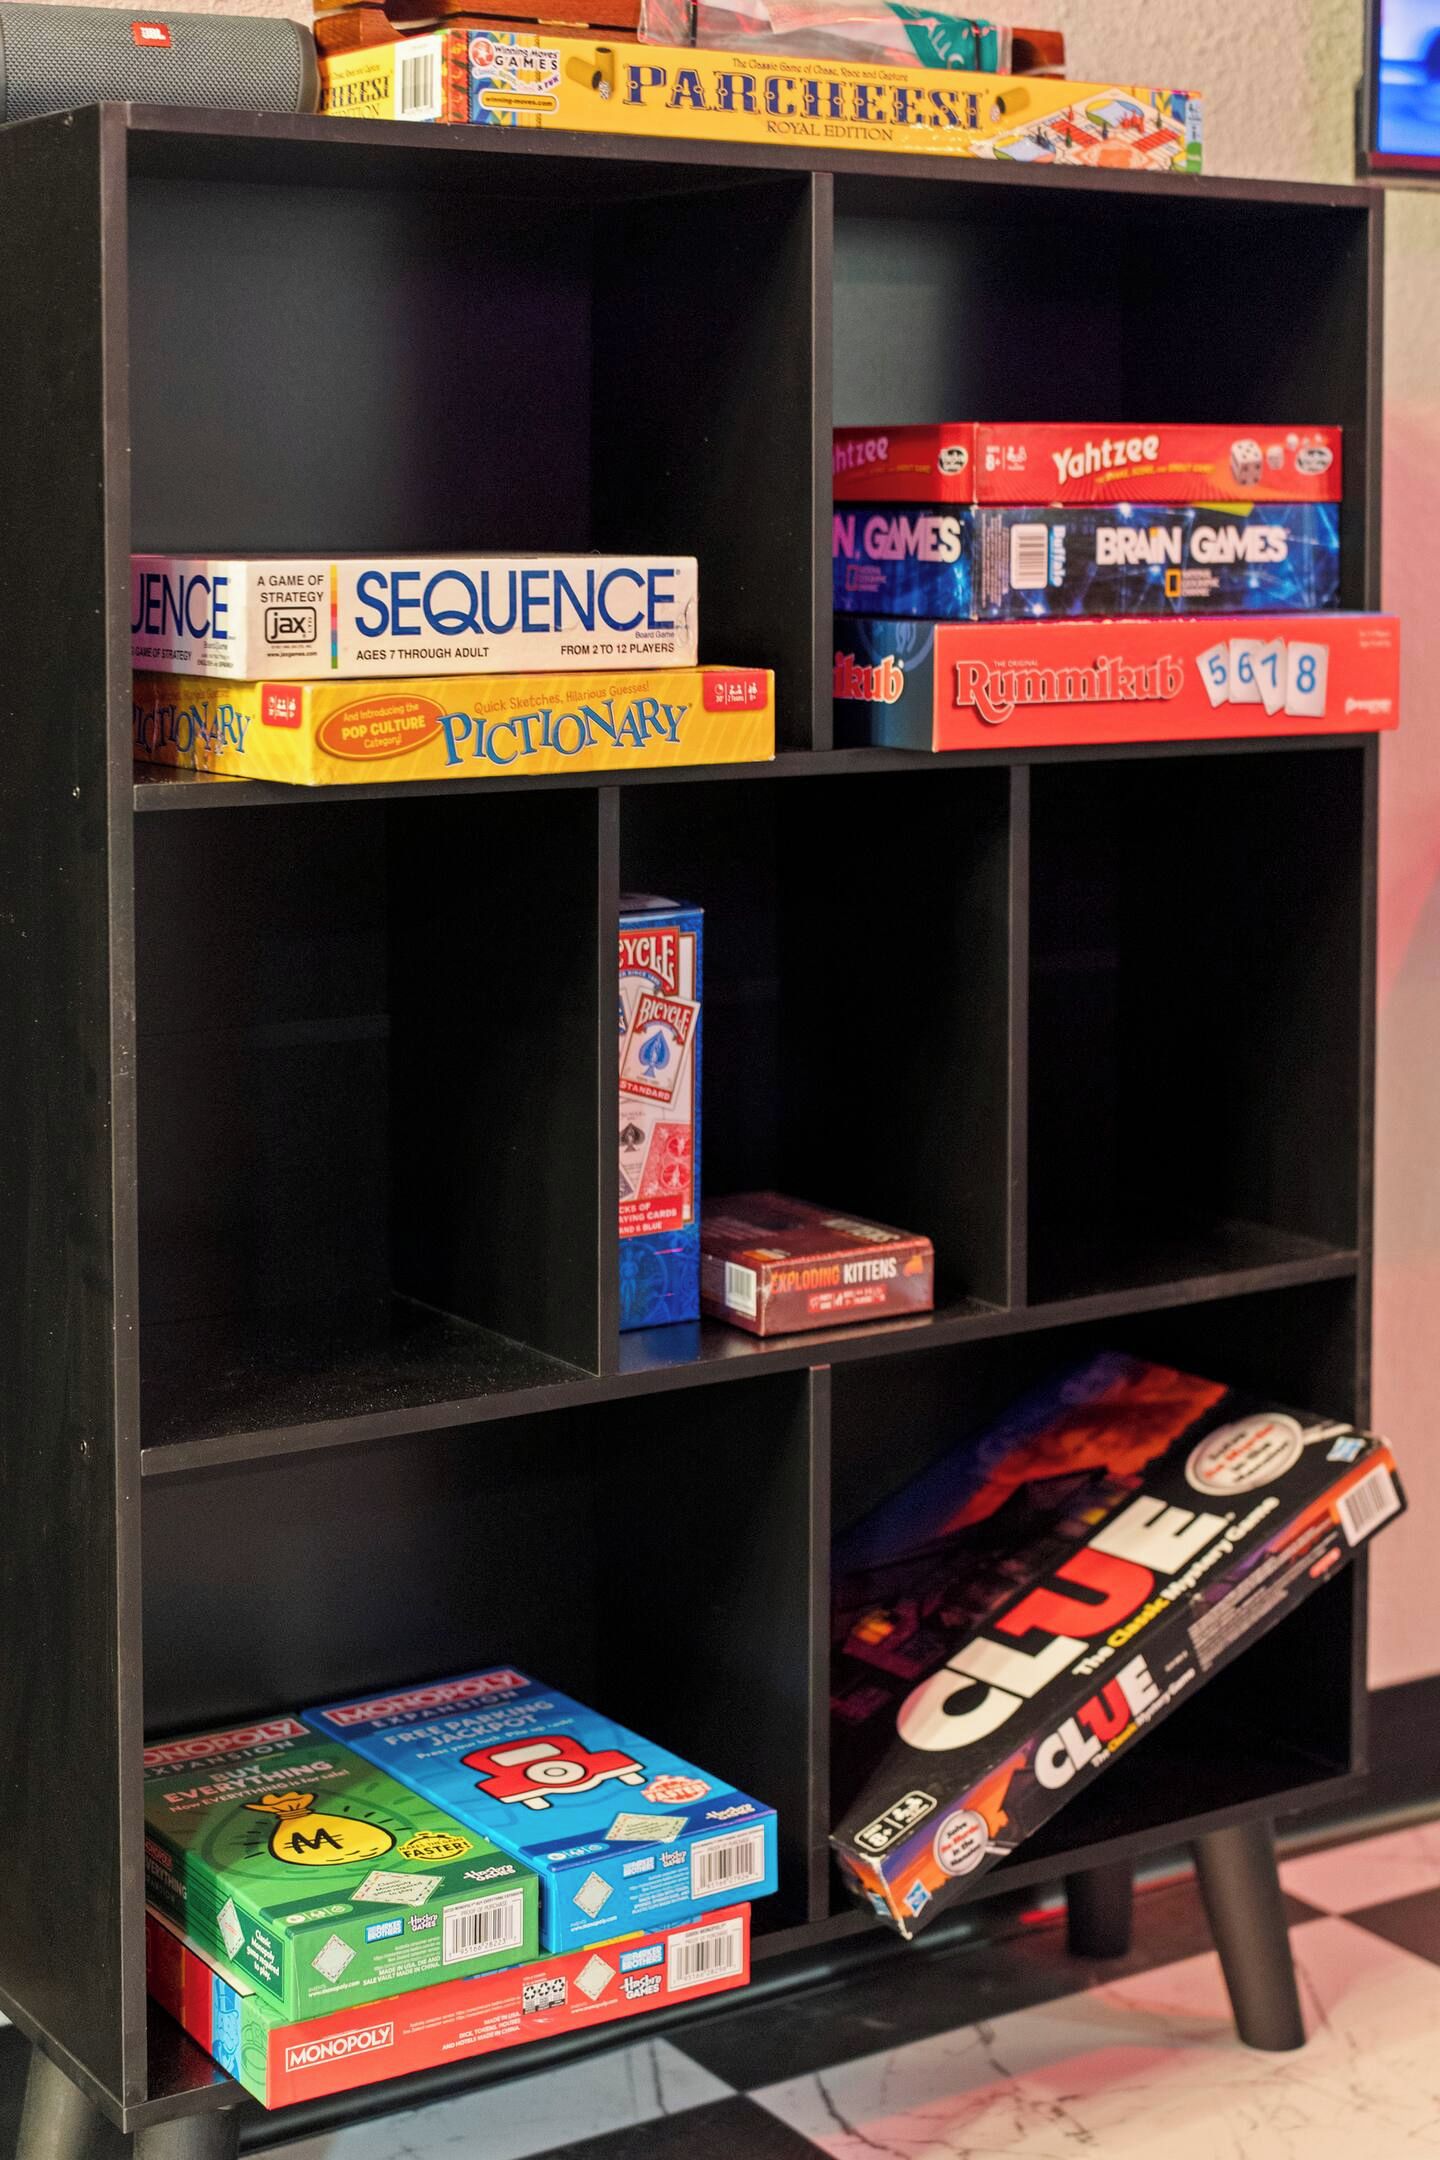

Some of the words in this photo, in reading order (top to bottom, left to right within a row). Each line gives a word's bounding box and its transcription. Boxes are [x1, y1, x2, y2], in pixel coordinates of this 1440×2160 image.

[495, 56, 558, 70] GAMES
[733, 58, 746, 67] The
[749, 60, 778, 70] Classic
[780, 63, 801, 72] Game
[623, 65, 985, 131] PARCHEESI
[767, 120, 821, 136] ROYAL
[824, 122, 893, 141] EDITION
[1052, 435, 1160, 486] Yahtzee
[864, 516, 962, 563] GAMES
[1190, 526, 1289, 564] GAMES
[257, 576, 265, 586] A
[269, 575, 304, 586] GAME
[308, 575, 324, 586] OF
[260, 591, 324, 603] STRATEGY
[355, 568, 674, 638] SEQUENCE
[271, 612, 306, 639] jax
[635, 631, 654, 639] Board
[656, 631, 674, 639] Game
[356, 649, 387, 660] AGES
[390, 649, 396, 660] 7
[399, 648, 452, 659] THROUGH
[455, 647, 489, 658] ADULT
[561, 645, 590, 655] FROM
[593, 644, 599, 655] 2
[601, 644, 613, 655] TO
[616, 644, 627, 654] 12
[630, 643, 674, 653] PLAYERS
[1208, 655, 1227, 686] 5
[1238, 652, 1253, 684] 6
[1261, 653, 1278, 688] 7
[1296, 654, 1316, 694] 8
[474, 700, 507, 714] Quick
[510, 694, 564, 709] Sketches,
[566, 688, 607, 701] Hilarious
[609, 681, 650, 697] Guesses!
[955, 655, 1184, 724] Rummikub
[344, 712, 359, 722] And
[360, 706, 405, 720] Introducing
[406, 702, 419, 711] the
[342, 725, 368, 740] POP
[370, 715, 426, 736] CULTURE
[436, 697, 687, 767] PICTIONARY
[364, 734, 402, 748] Category!
[638, 996, 692, 1042] BICYCLE
[619, 1080, 671, 1101] STANDARD
[638, 1203, 651, 1211] OF
[647, 1209, 677, 1220] CARDS
[643, 1222, 662, 1231] BLUE
[770, 1265, 840, 1295] EXPLODING
[844, 1257, 898, 1284] KITTENS
[1072, 1646, 1115, 1675] The
[1225, 1497, 1280, 1542] Game
[896, 1495, 1230, 1752] CLUE
[335, 1672, 514, 1724] MONOPOLY
[370, 1689, 519, 1728] EXPANSION
[384, 1724, 446, 1746] FREE
[444, 1700, 555, 1730] PARKING
[430, 1714, 539, 1747] JACKPOT
[1034, 1654, 1160, 1790] CLUE
[162, 1760, 334, 1804] EVERYTHING
[209, 1765, 262, 1782] BUY
[170, 1803, 200, 1813] Now
[203, 1783, 288, 1806] EVERYTHING
[290, 1779, 300, 1787] is
[301, 1775, 319, 1784] for
[403, 1841, 470, 1858] FASTER!
[427, 1840, 441, 1848] THE
[443, 1837, 464, 1845] GAME
[428, 1956, 440, 1964] AND
[363, 1978, 377, 1986] SALE
[378, 1974, 395, 1982] VAULT
[396, 1970, 413, 1978] MADE
[619, 1975, 661, 1993] Hasbro
[626, 1984, 659, 1999] GAMES
[483, 2016, 500, 2025] MADE
[290, 2026, 390, 2067] MONOPOLY
[478, 2034, 494, 2042] MADE
